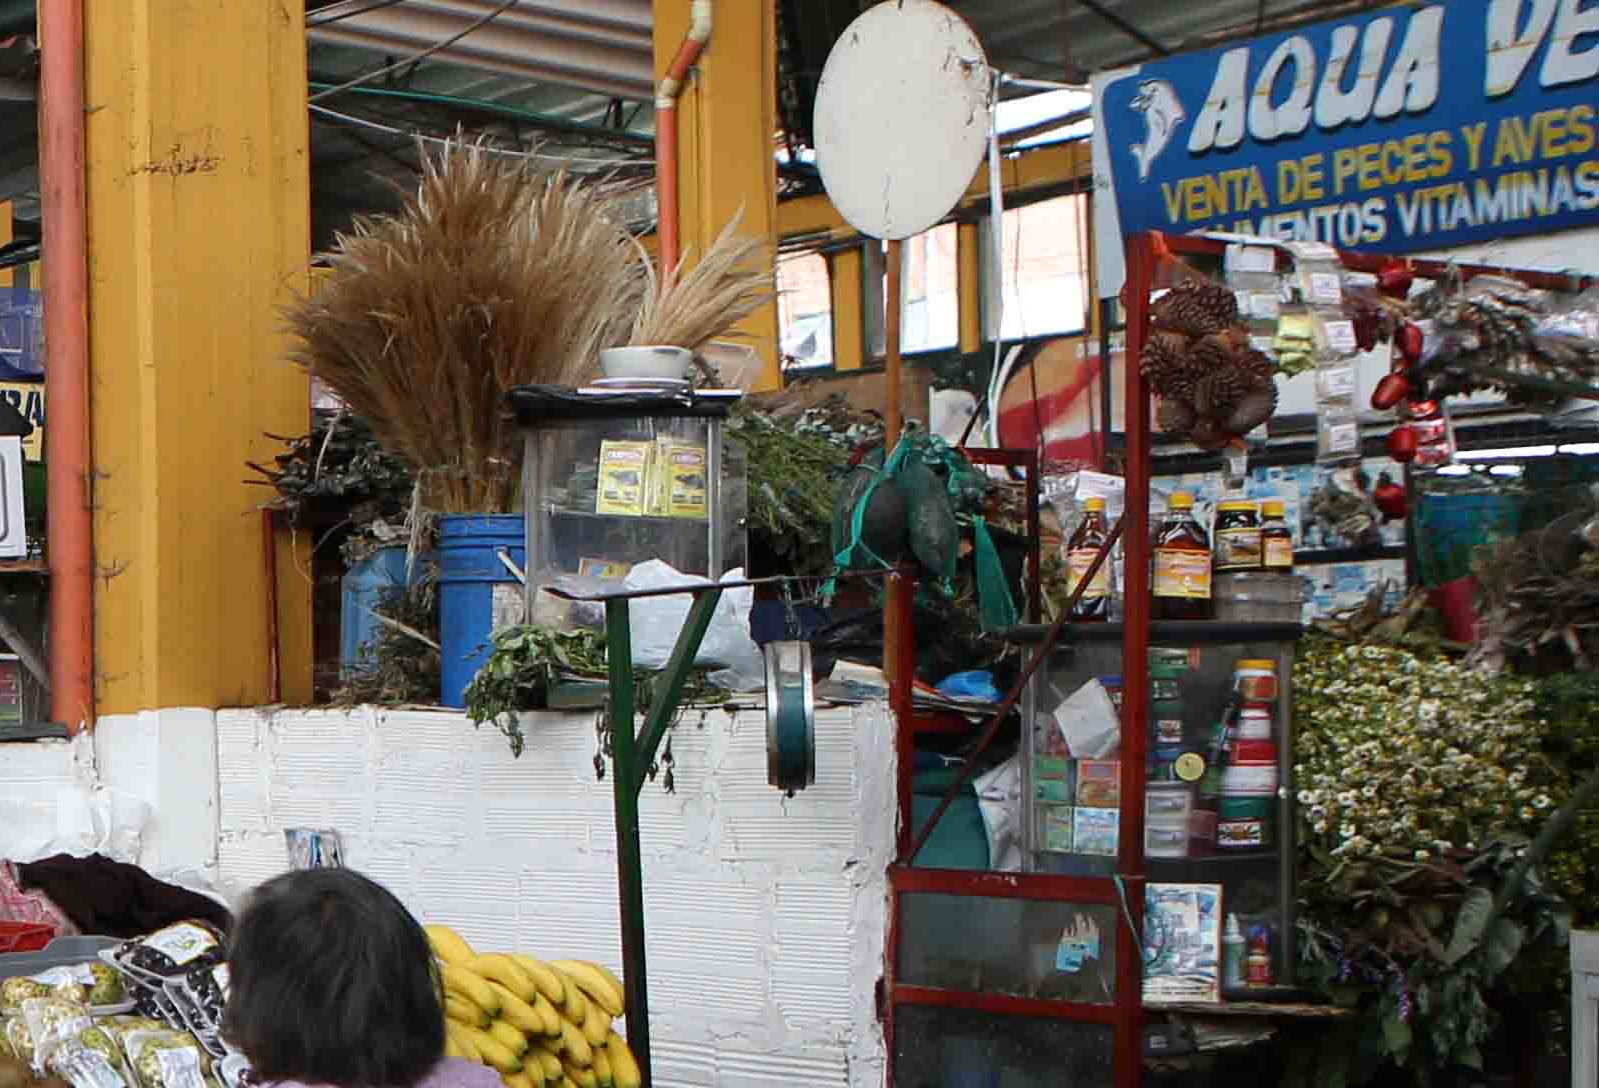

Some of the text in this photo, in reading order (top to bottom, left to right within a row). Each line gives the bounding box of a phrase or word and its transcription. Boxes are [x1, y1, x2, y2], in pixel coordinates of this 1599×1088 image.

[1187, 6, 1445, 153] AQUA
[1160, 164, 1269, 224] VENTA
[1276, 153, 1324, 205] DE
[1333, 130, 1454, 196] PECES
[1460, 121, 1488, 173] Y
[1216, 160, 1599, 247] MENTOS VITAMINAS
